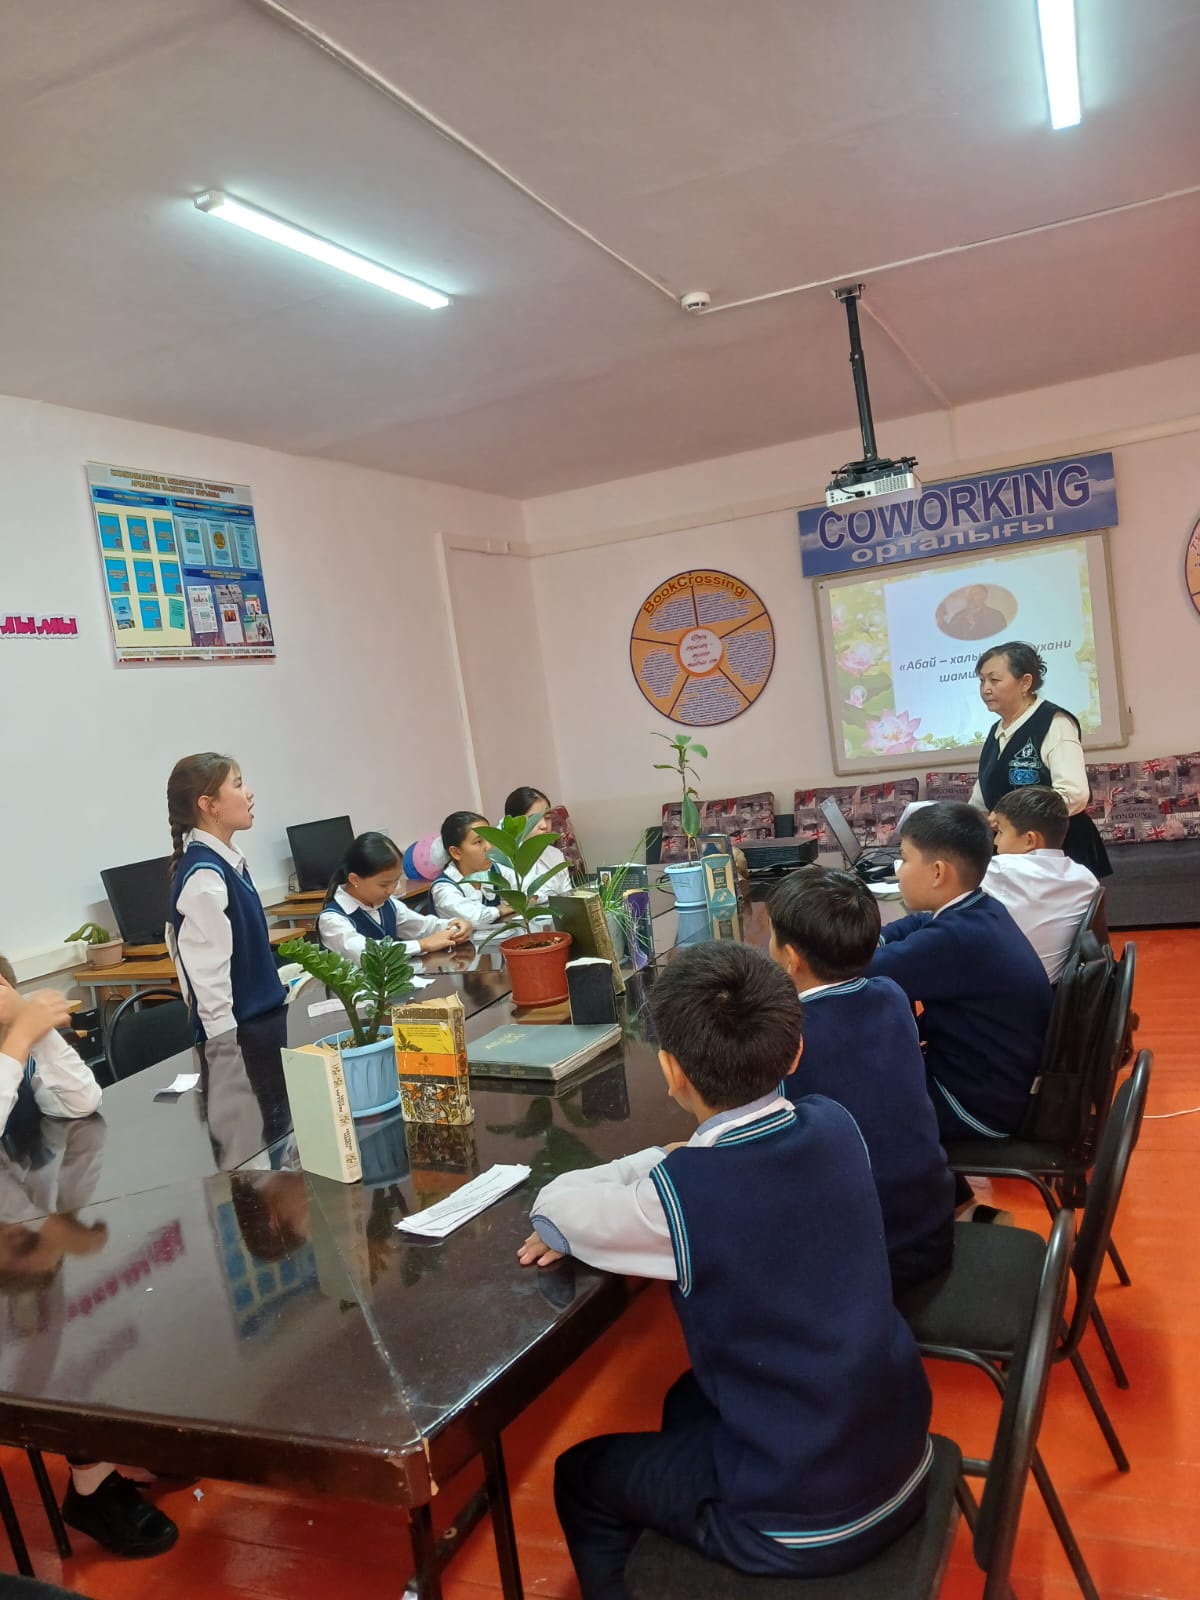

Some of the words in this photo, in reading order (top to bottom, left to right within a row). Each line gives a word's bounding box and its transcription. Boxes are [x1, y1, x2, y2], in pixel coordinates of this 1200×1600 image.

[818, 464, 1091, 549] COWORKING
[851, 517, 1055, 563] орталығы
[643, 575, 745, 614] BookCrossing
[899, 656, 936, 671] «Абай
[950, 653, 981, 665] халы
[1033, 640, 1072, 653] ухани
[939, 670, 978, 683] шамш
